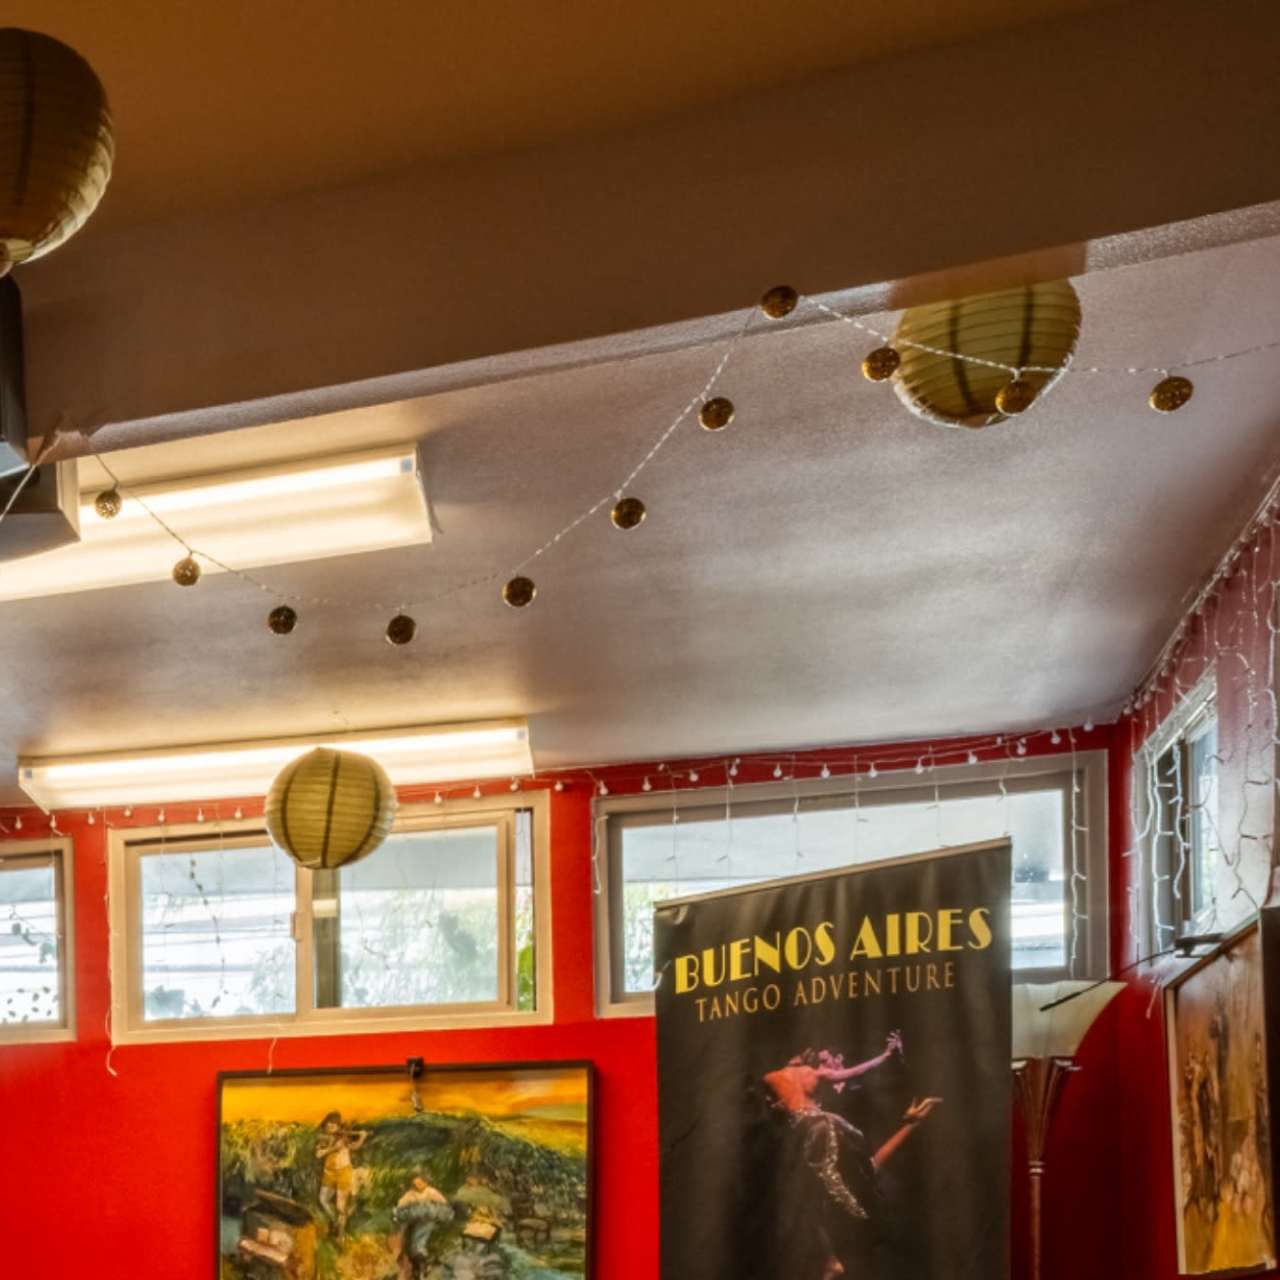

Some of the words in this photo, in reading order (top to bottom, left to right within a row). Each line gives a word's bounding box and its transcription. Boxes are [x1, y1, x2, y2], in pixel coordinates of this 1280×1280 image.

[675, 921, 836, 995] BUENOS
[850, 908, 994, 961] AIRES
[695, 983, 781, 1023] TANGO
[794, 961, 956, 1007] ADVENTURE
